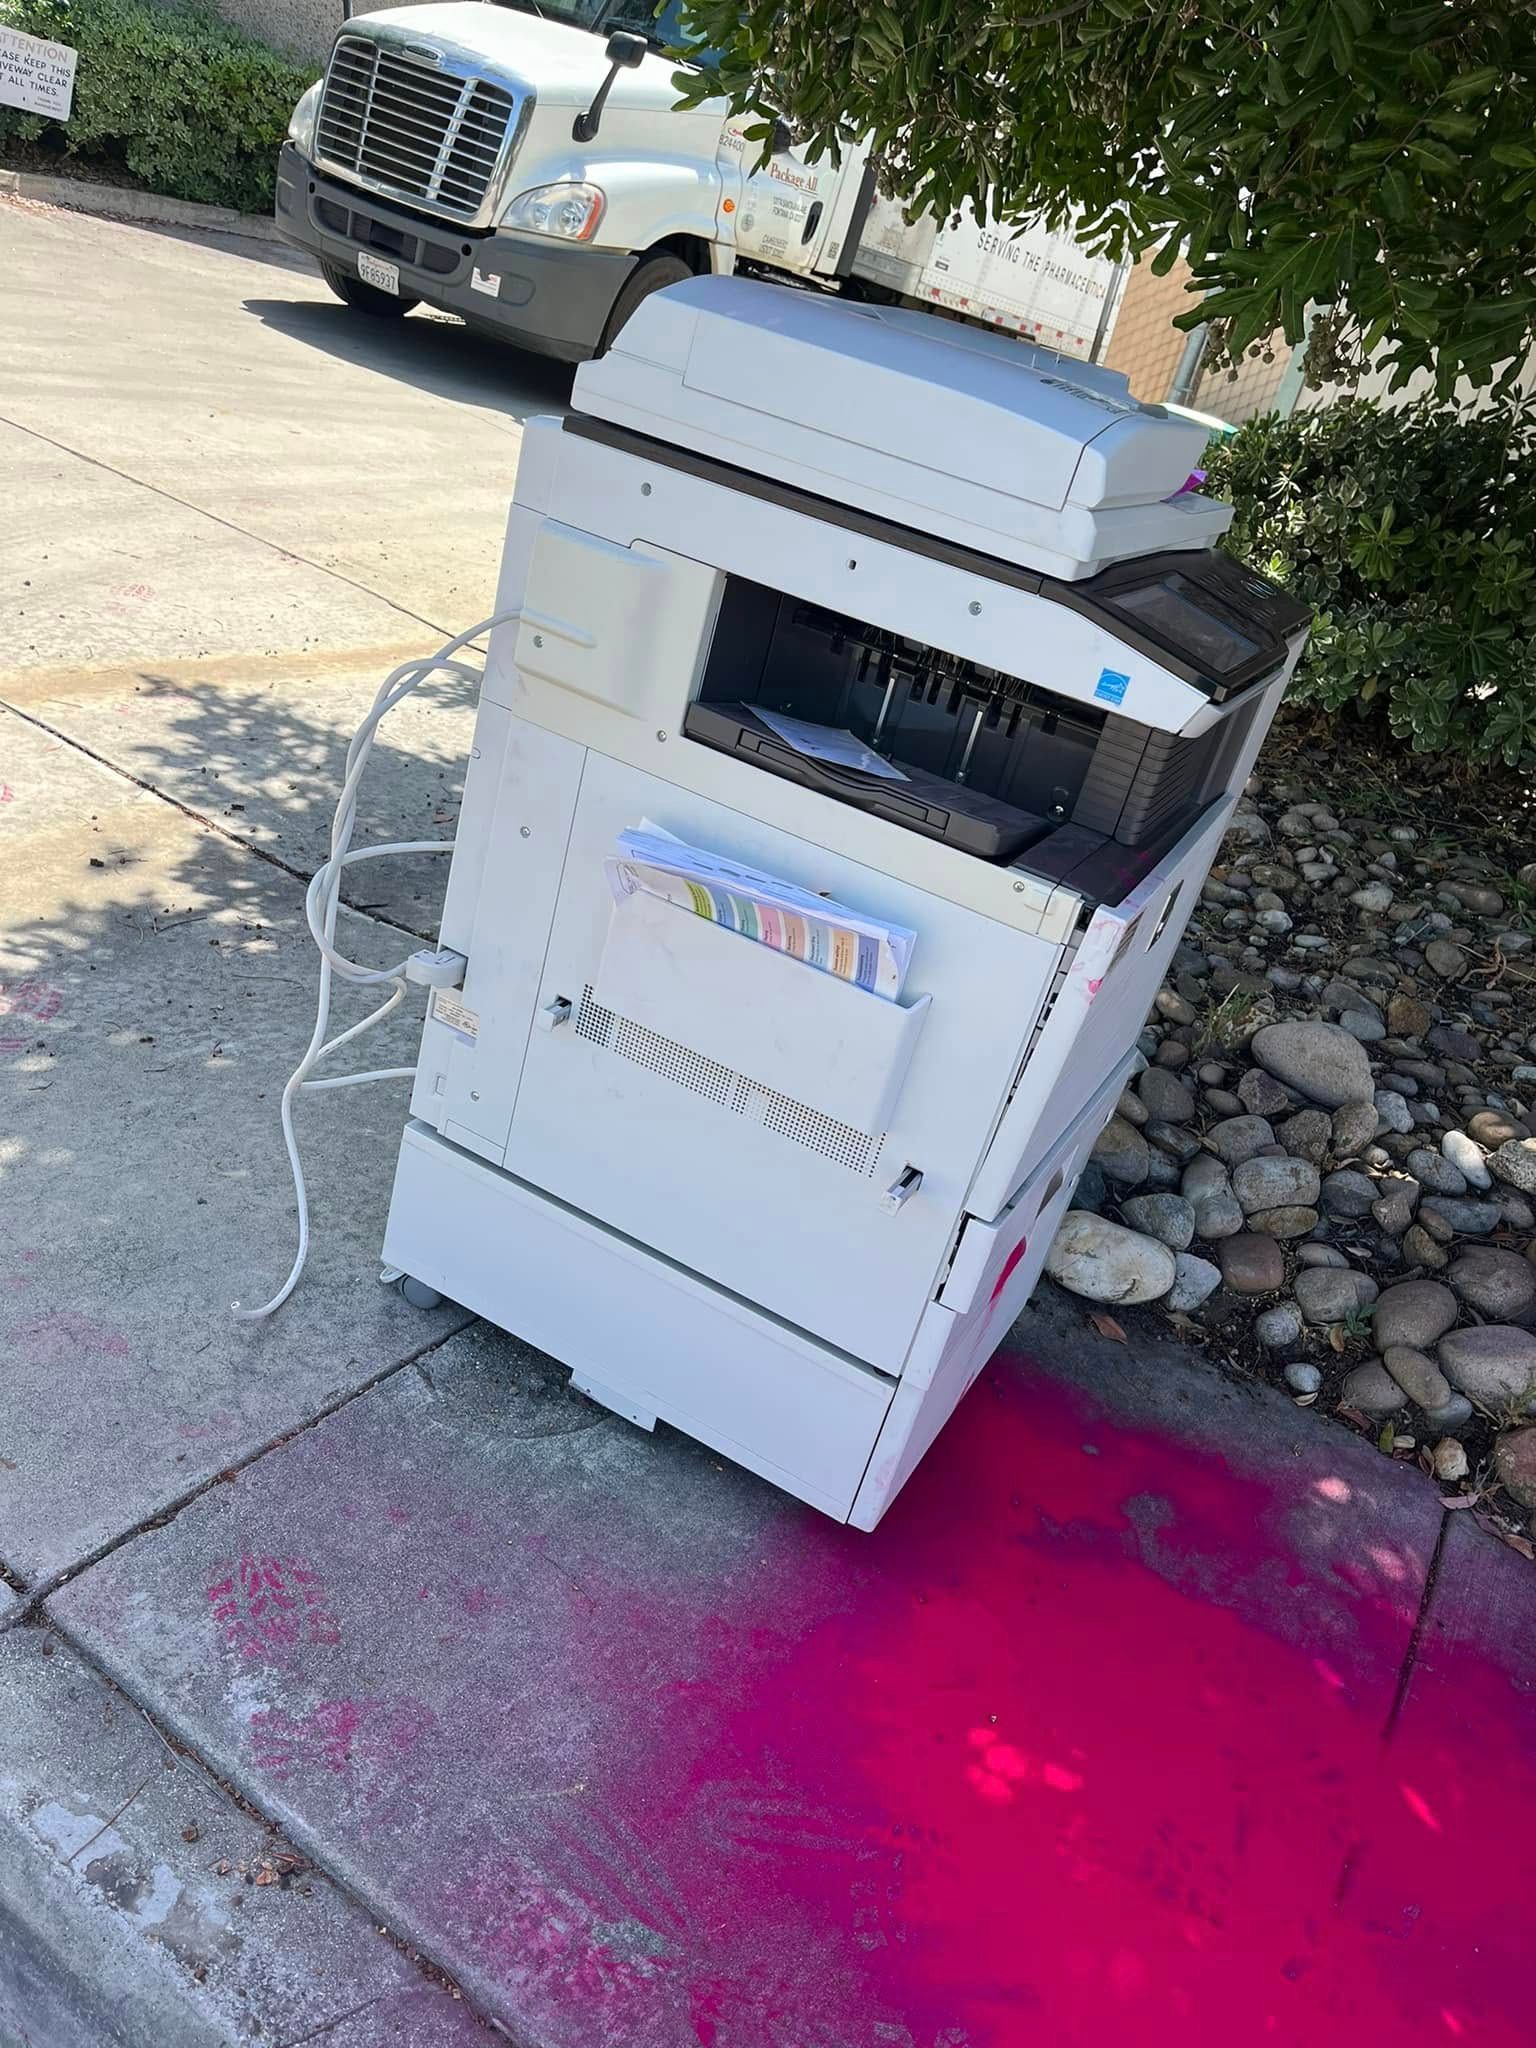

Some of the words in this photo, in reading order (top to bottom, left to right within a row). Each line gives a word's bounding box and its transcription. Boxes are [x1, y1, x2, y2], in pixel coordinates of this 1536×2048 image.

[0, 31, 68, 63] TTENTION
[0, 48, 20, 62] ASE
[24, 54, 47, 69] KEEP
[51, 64, 71, 78] THIS
[8, 75, 24, 87] ALL
[37, 72, 68, 88] CLEAR
[770, 162, 805, 188] Package
[805, 175, 818, 191] All
[977, 231, 1021, 263] SERVING
[1023, 251, 1041, 272] THE
[361, 264, 395, 290] 9F85937
